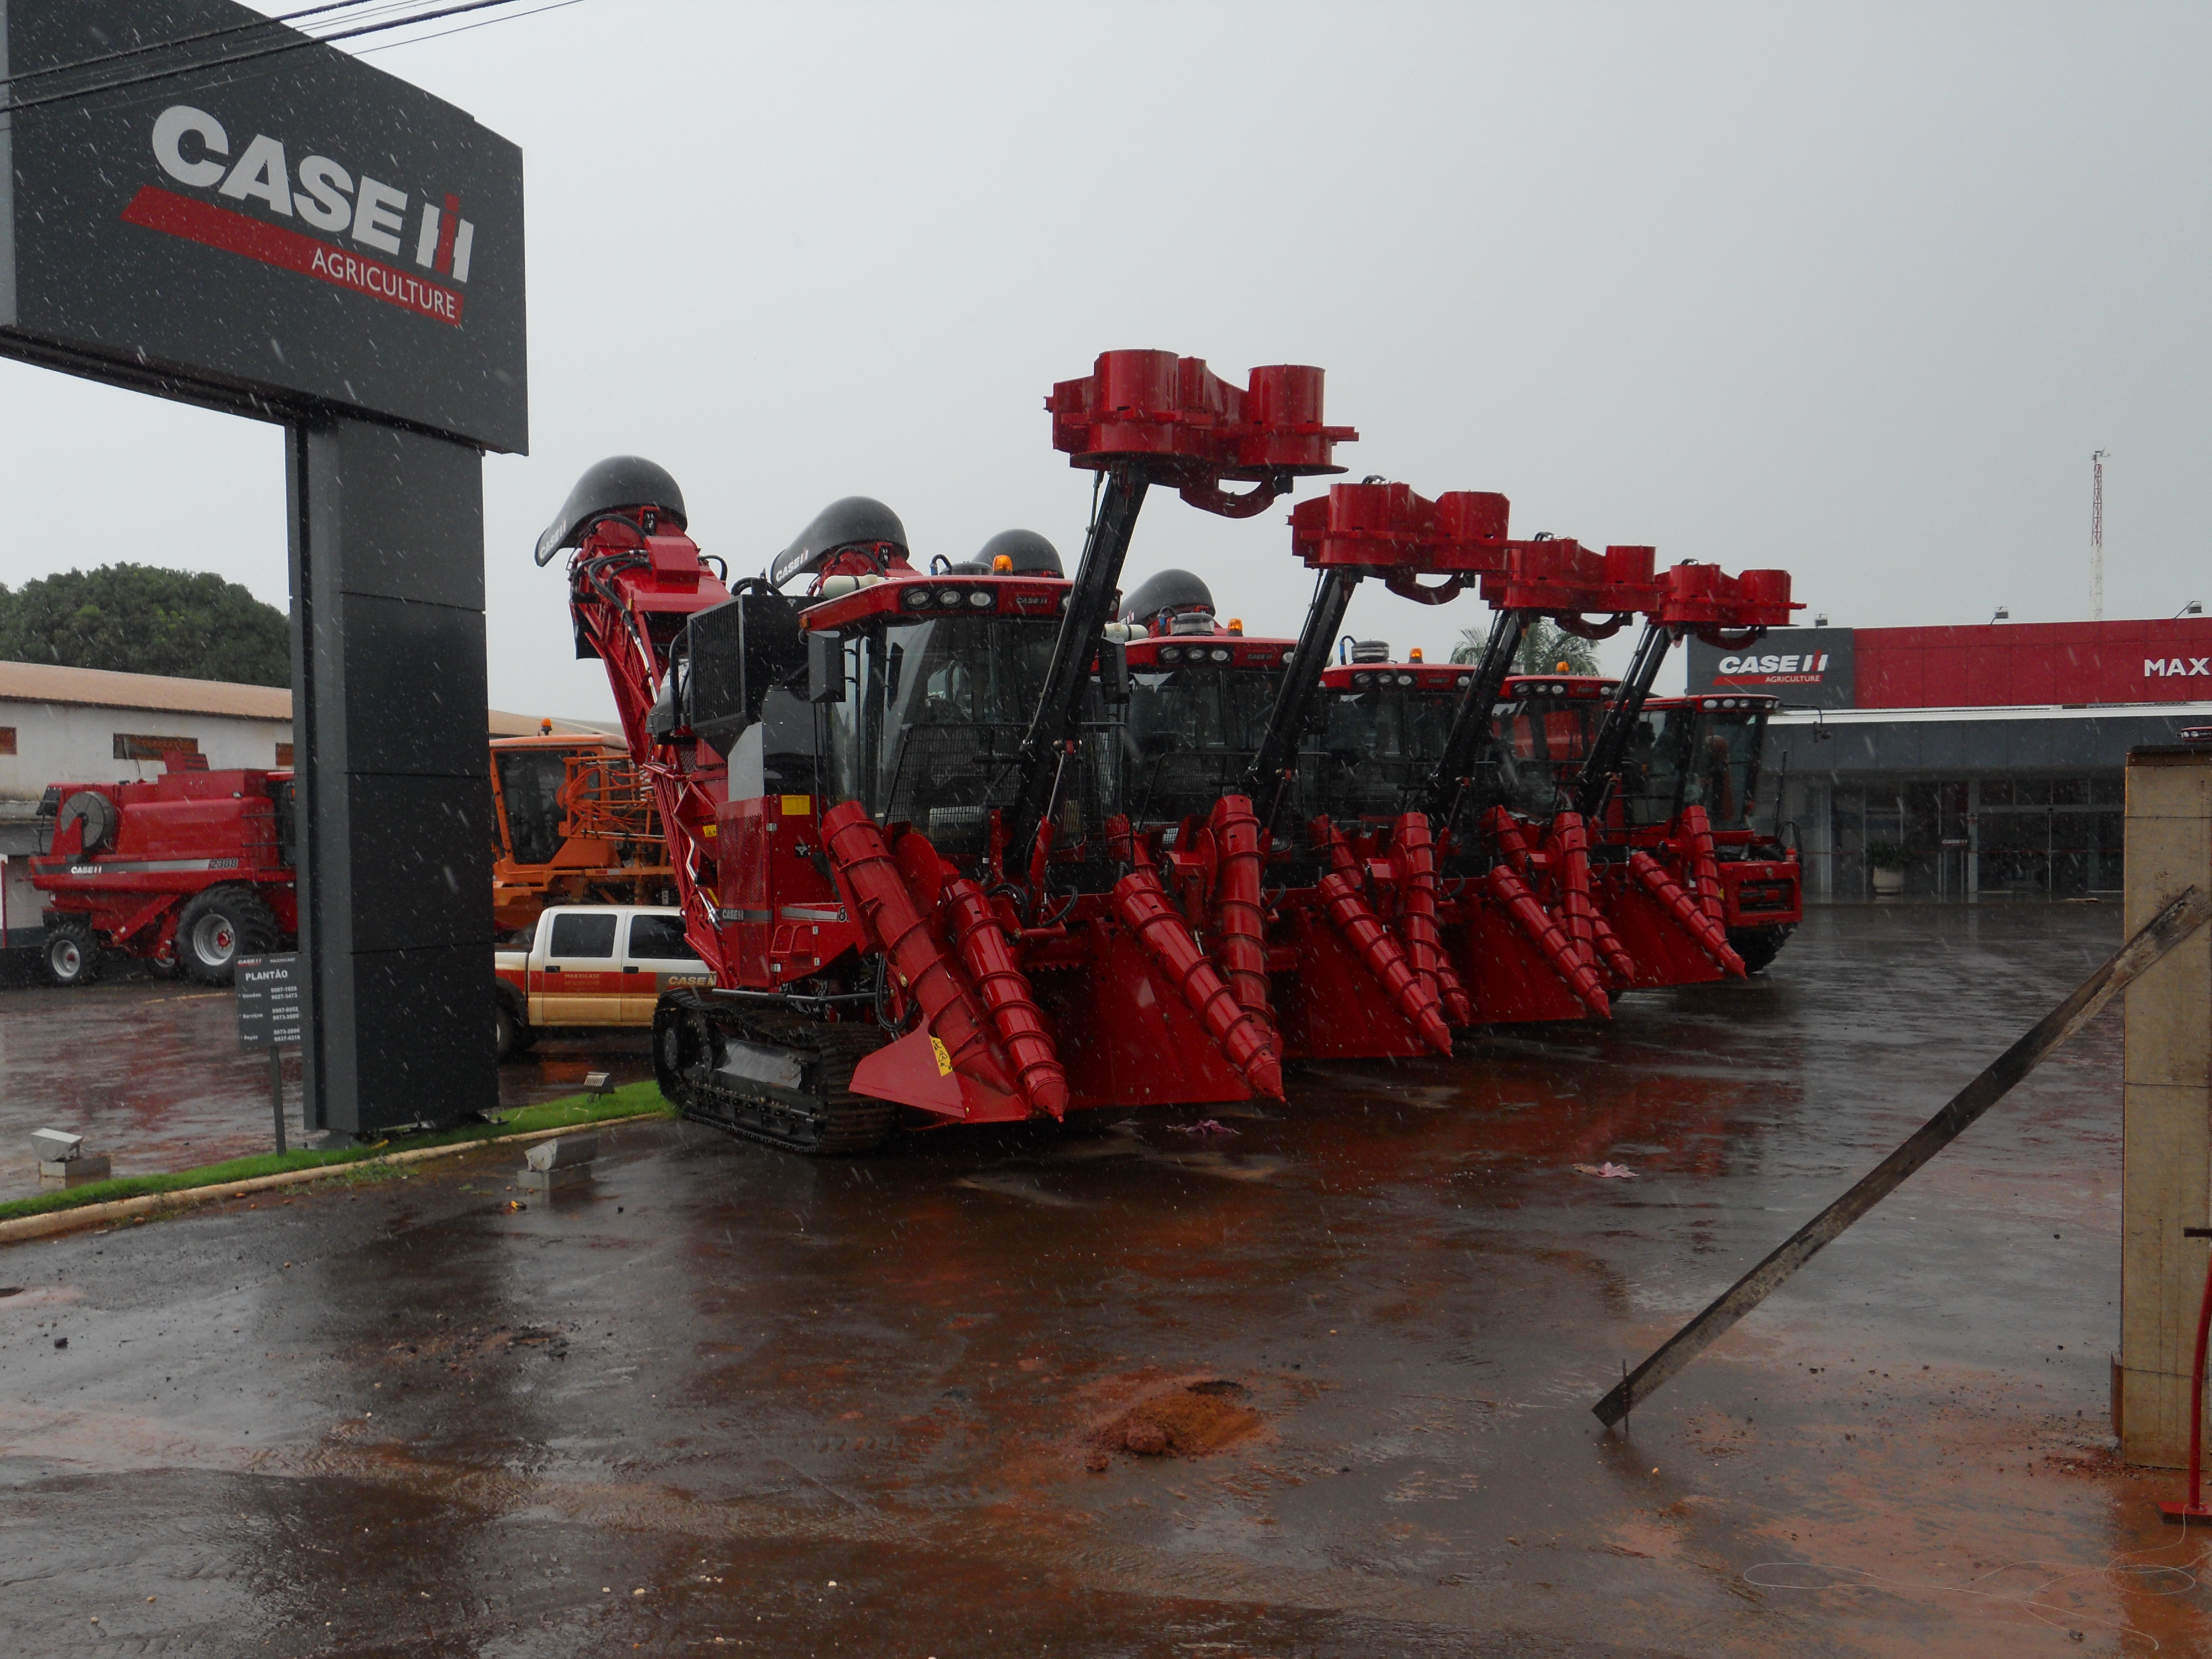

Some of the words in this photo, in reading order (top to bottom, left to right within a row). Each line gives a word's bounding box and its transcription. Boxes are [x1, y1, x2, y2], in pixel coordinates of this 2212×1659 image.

[152, 105, 408, 255] CASE
[311, 247, 456, 320] AGRICULTURE
[540, 528, 560, 559] CASE
[776, 556, 800, 582] CASE
[1719, 655, 1800, 674] CASE
[1765, 675, 1820, 683] AGRICULTURE
[210, 857, 238, 869] 2388
[71, 865, 93, 874] CASE
[722, 909, 738, 919] CASE
[245, 969, 288, 981] PLANTÃO
[668, 976, 706, 985] CASE
